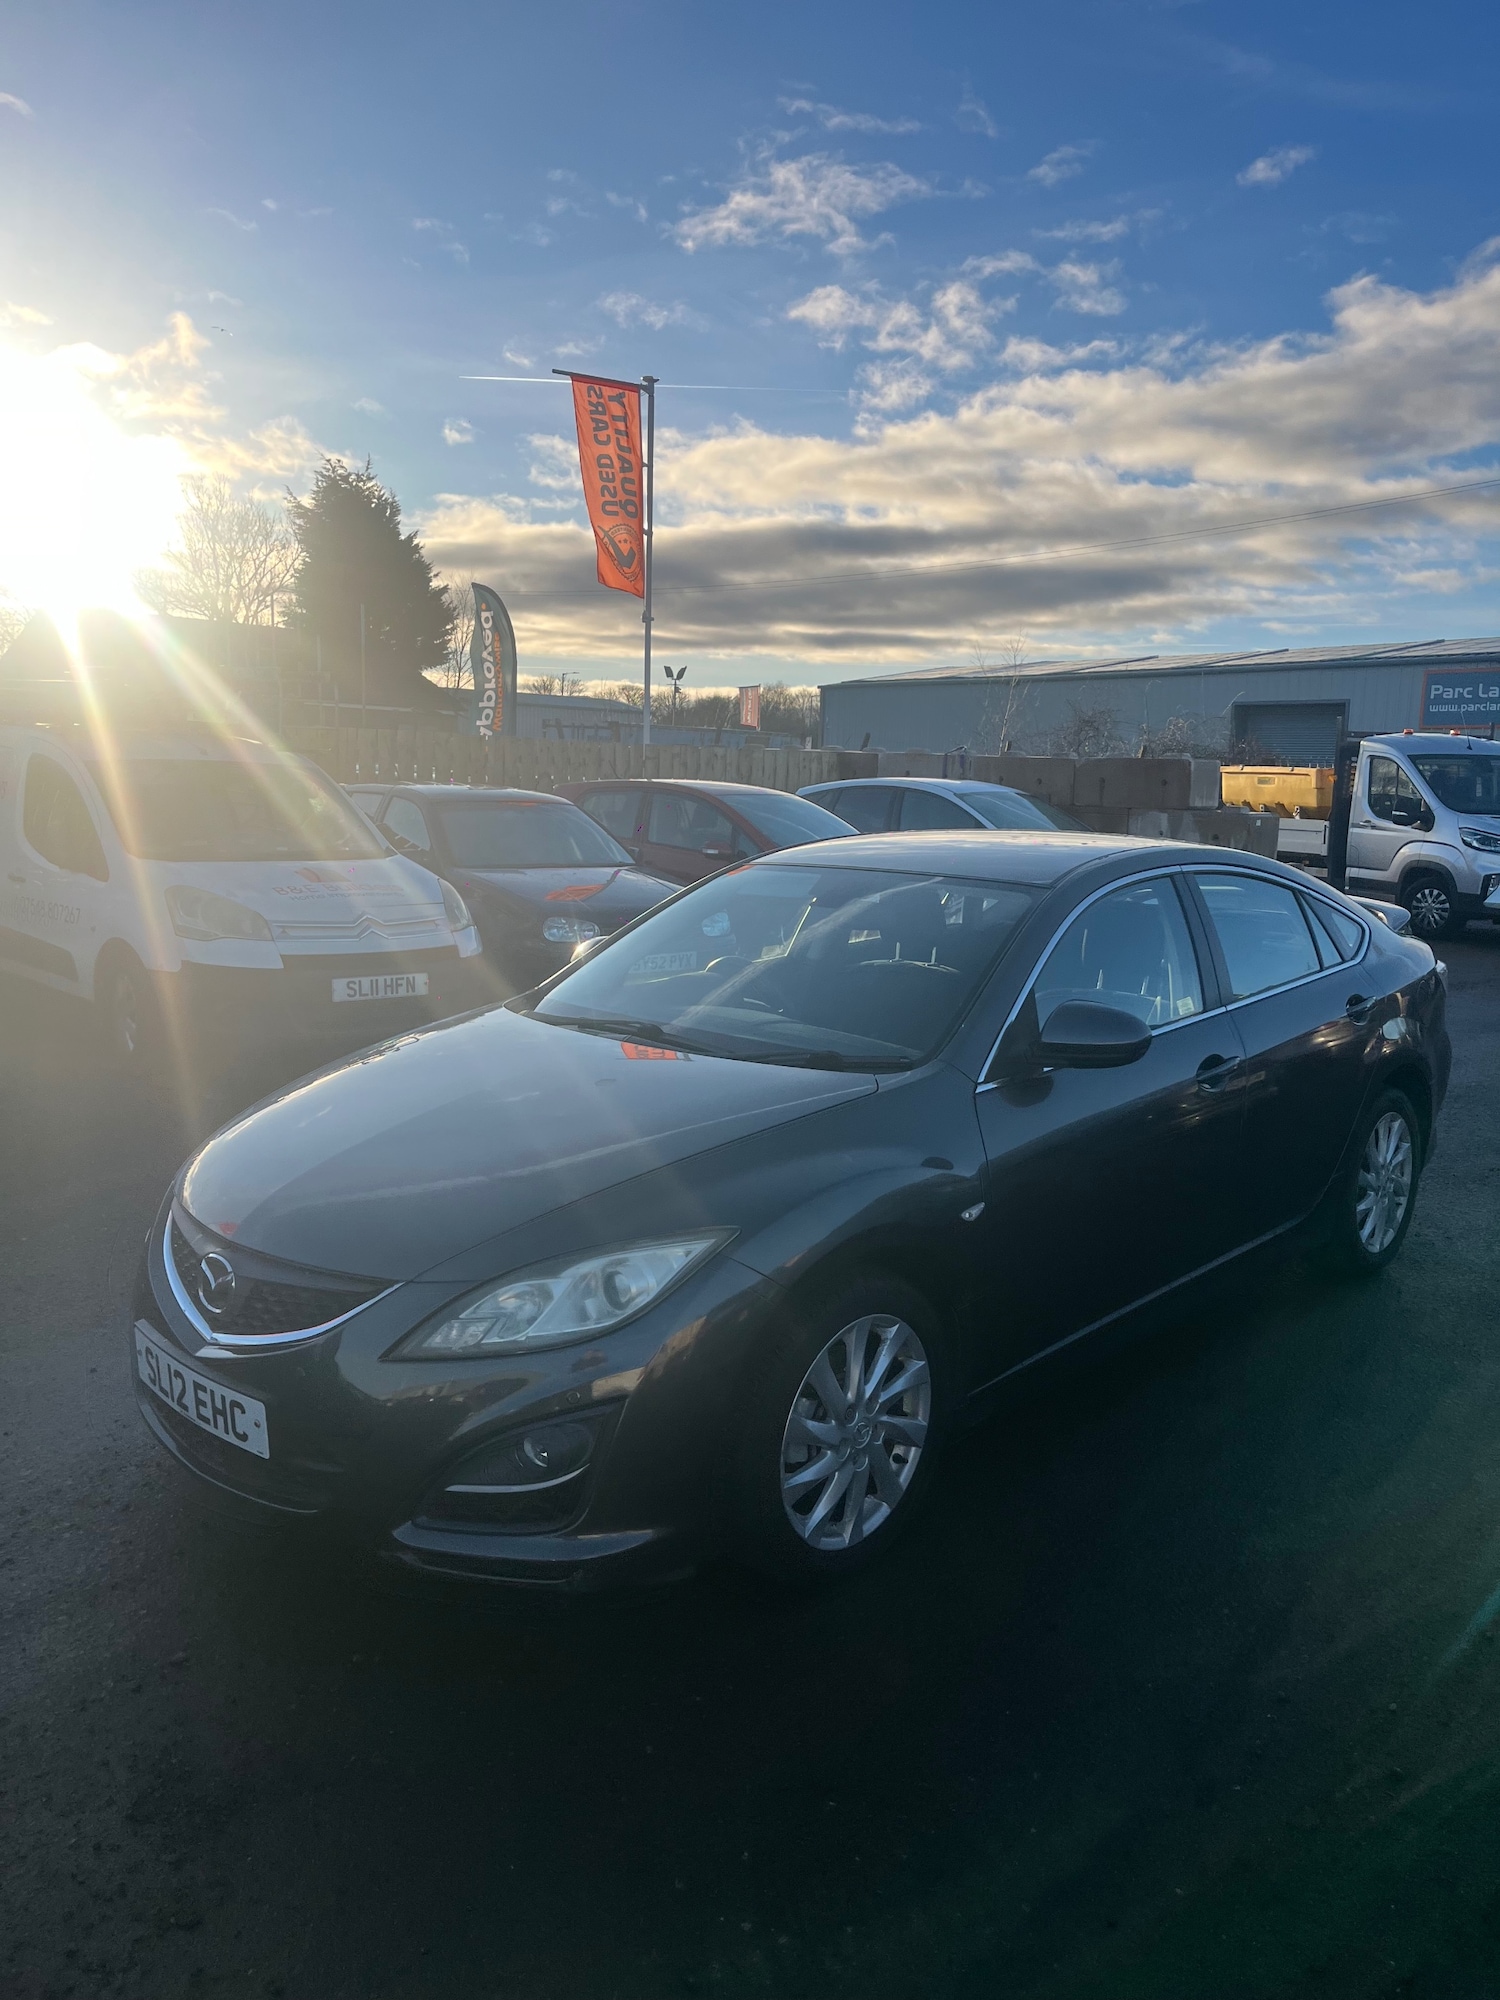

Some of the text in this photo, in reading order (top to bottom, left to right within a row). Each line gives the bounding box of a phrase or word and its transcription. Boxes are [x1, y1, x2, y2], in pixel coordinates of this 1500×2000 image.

[1430, 685, 1473, 699] Parc
[272, 884, 320, 896] B&E
[669, 953, 693, 968] PYX
[346, 976, 416, 998] SL11 HFN
[145, 1345, 249, 1443] SL12 EHC
